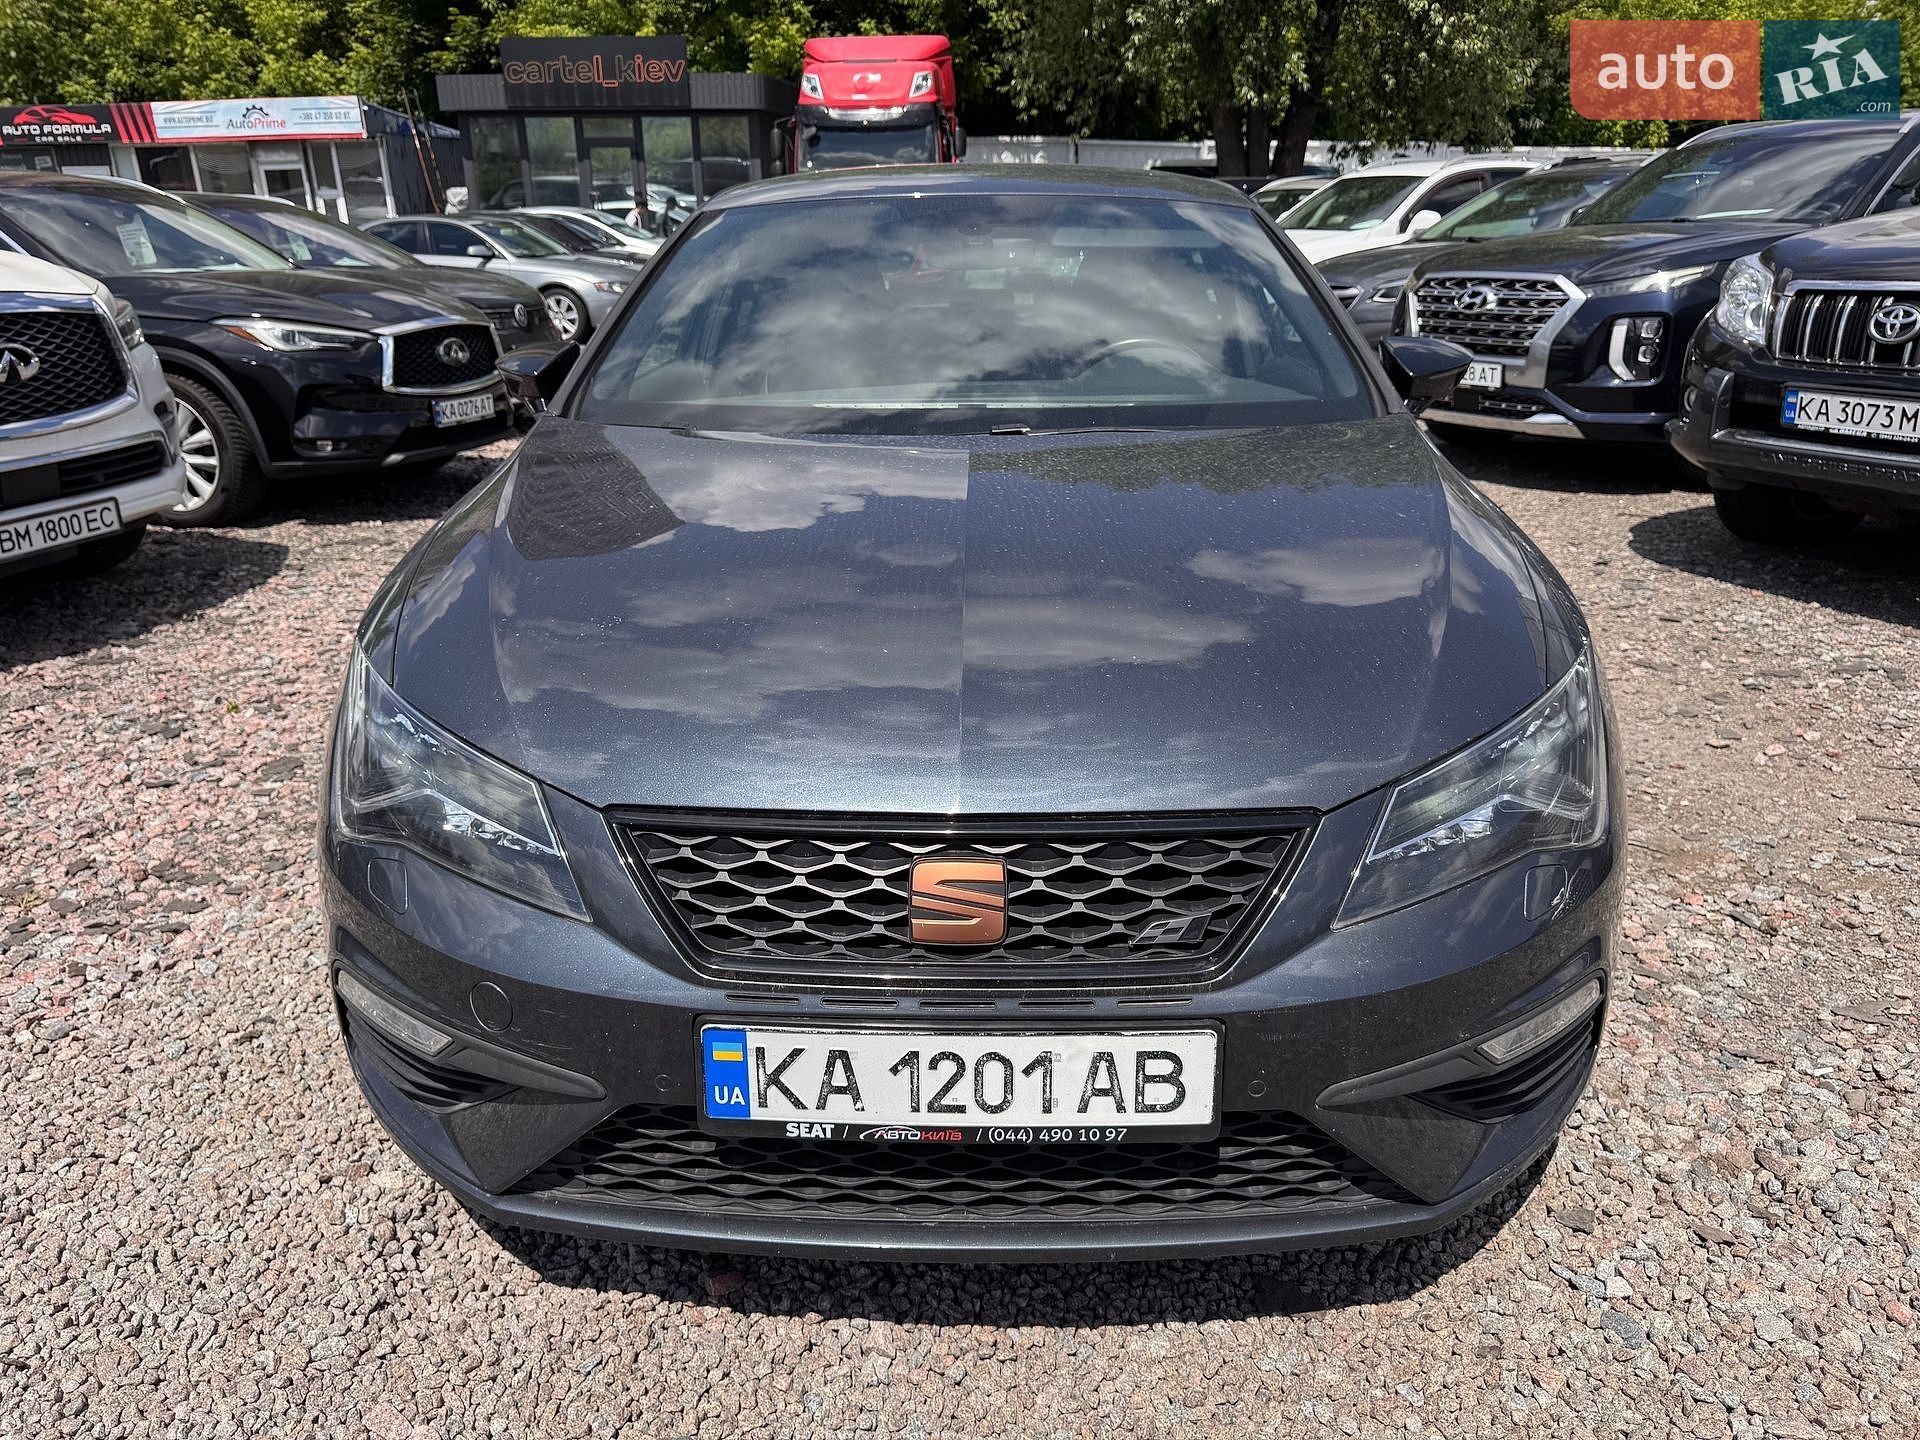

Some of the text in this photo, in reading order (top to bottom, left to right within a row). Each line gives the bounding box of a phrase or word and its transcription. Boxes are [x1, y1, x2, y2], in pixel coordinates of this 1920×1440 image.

[504, 53, 686, 88] cartel_kiev
[2, 123, 112, 136] AUTO FORMULA
[226, 117, 286, 130] AutoPrime
[1478, 367, 1498, 383] AT
[441, 402, 457, 421] KA
[1785, 410, 1795, 418] UA
[1797, 396, 1830, 423] KA
[1836, 400, 1896, 429] 3073
[0, 506, 114, 553] BM 1800 EC
[755, 1046, 1186, 1114] KA 1201 AB
[714, 1085, 746, 1106] UA
[785, 1122, 835, 1139] SEAT
[988, 1127, 1034, 1143] (044)
[1039, 1128, 1073, 1142] 490
[1079, 1128, 1100, 1142] 10
[1105, 1128, 1128, 1142] 97
